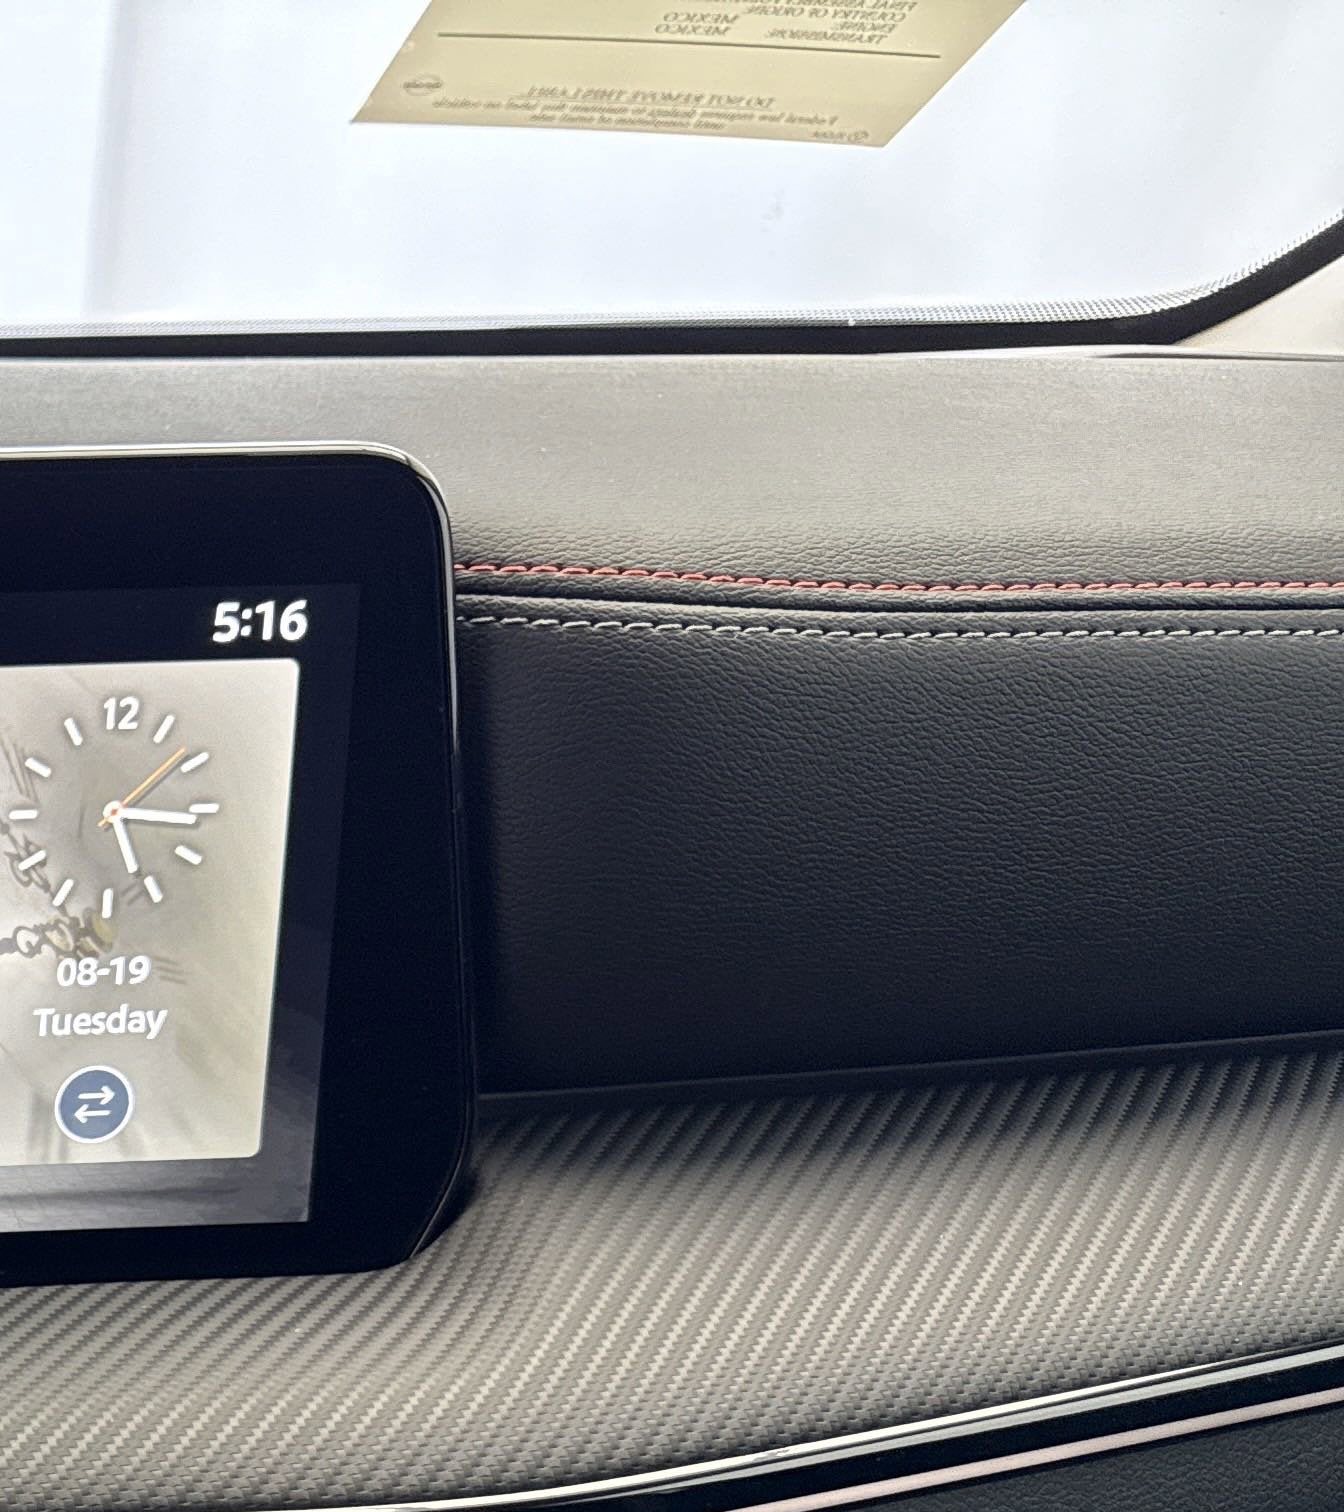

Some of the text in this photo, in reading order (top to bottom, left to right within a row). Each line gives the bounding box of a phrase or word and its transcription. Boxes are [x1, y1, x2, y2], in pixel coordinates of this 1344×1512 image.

[212, 600, 309, 643] 5:16
[103, 696, 140, 731] 12
[56, 955, 150, 986] 08-19
[33, 1004, 168, 1040] Tuesday
